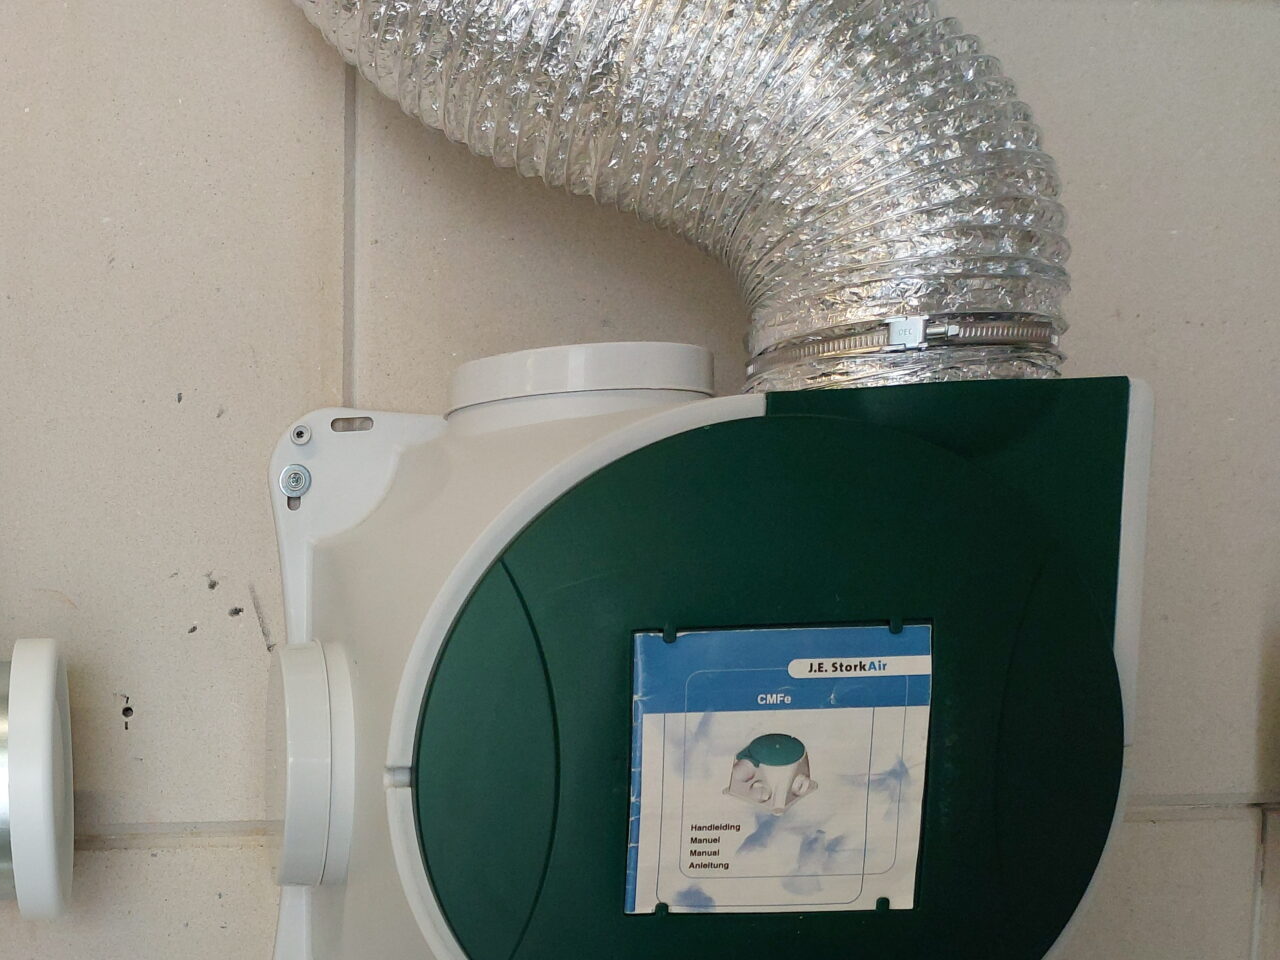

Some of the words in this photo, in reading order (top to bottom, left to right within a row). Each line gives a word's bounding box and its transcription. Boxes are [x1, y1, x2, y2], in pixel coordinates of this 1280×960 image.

[808, 662, 828, 673] J.E.
[831, 660, 887, 673] StorkAir
[757, 693, 792, 704] CMFe
[690, 824, 741, 832] Handleiding
[690, 836, 721, 844] Manuel
[689, 849, 720, 857] Manual
[688, 862, 729, 870] Anleitung
